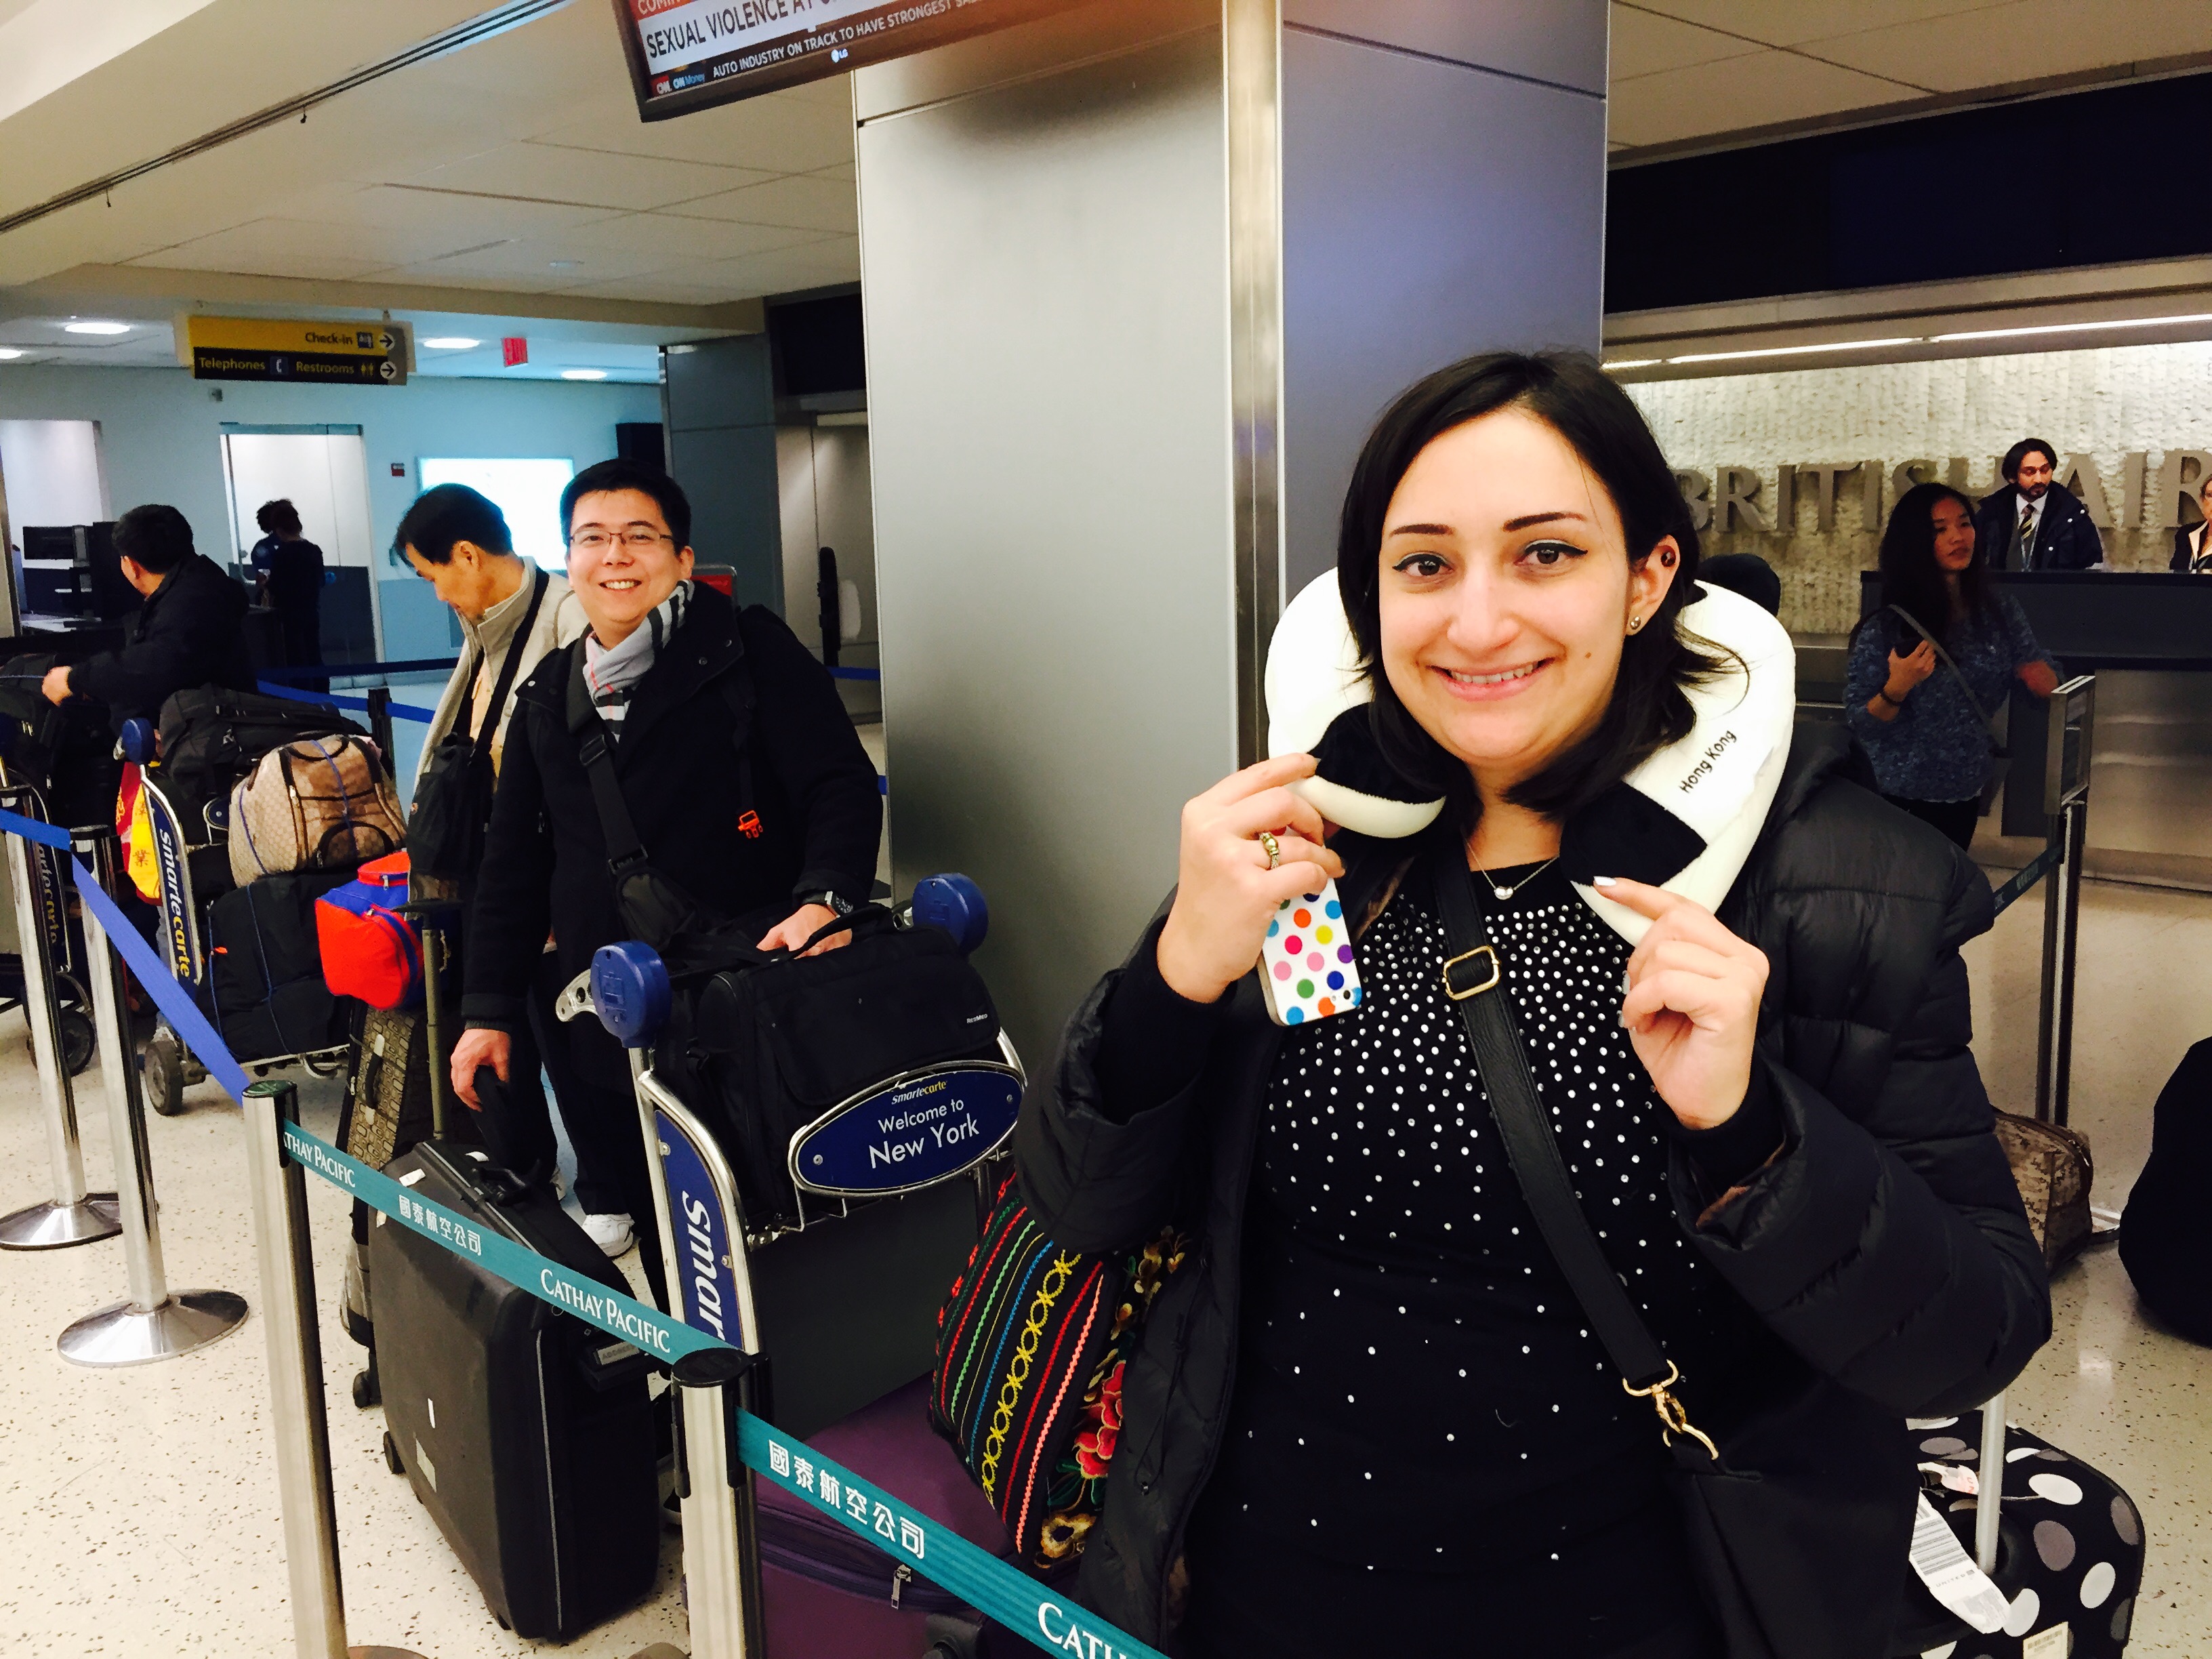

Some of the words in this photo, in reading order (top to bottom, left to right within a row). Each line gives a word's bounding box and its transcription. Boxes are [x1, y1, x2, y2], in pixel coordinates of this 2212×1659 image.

[647, 19, 706, 58] SEXUAL
[705, 0, 788, 39] VIOLENCE
[713, 60, 738, 78] AUTO
[739, 47, 784, 68] INDUSTRY
[787, 41, 802, 56] ON
[804, 32, 838, 51] TRACK
[839, 26, 854, 41] TO
[855, 17, 886, 36] HAVE
[886, 0, 951, 28] STRONGEST
[199, 356, 266, 371] Telephones
[305, 331, 353, 345] Check-in
[295, 362, 354, 375] Restrooms
[1679, 760, 1713, 794] Hong
[1704, 730, 1737, 760] Kong
[869, 1137, 925, 1169] New
[930, 1113, 980, 1149] York
[878, 1105, 947, 1134] Welcome
[950, 1099, 964, 1113] to
[314, 1145, 356, 1188] PACIFIC
[398, 1194, 482, 1256] 國泰航空公司
[540, 1269, 603, 1319] CATHAY
[606, 1297, 670, 1353] PACIFIC
[769, 1439, 924, 1559] 國泰航空公司
[1936, 1573, 1966, 1588] UNITED
